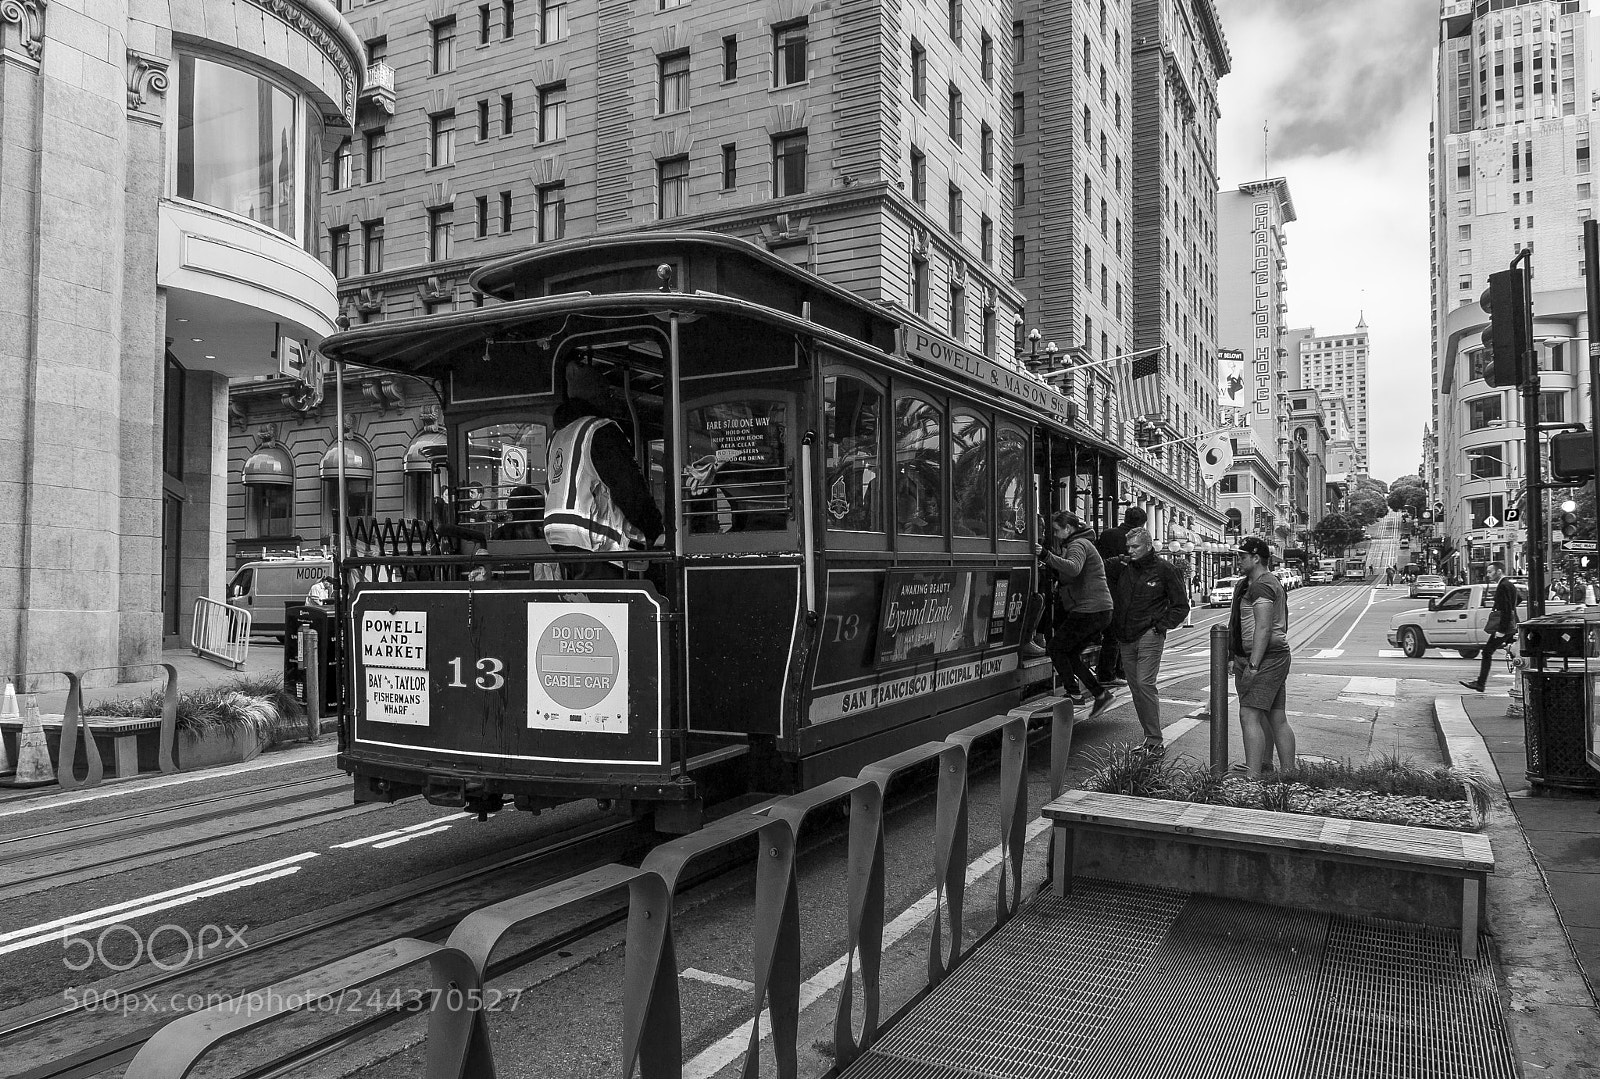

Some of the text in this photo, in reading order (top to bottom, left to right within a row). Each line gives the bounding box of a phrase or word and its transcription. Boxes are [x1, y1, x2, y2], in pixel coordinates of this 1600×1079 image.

[1254, 203, 1270, 415] CHANCELLOR HOTEL
[916, 334, 985, 379] POWELL
[990, 369, 999, 386] &
[1004, 374, 1047, 406] MASON
[706, 421, 722, 430] FARE
[740, 418, 754, 428] ONE
[755, 417, 770, 426] WAY
[929, 583, 951, 594] BEAUTY
[365, 620, 423, 634] POWELL
[551, 626, 602, 641] DO NOT
[832, 614, 860, 643] 13
[380, 634, 408, 645] AND
[559, 640, 594, 654] PASS
[364, 644, 423, 659] MARKET
[448, 656, 505, 690] 13
[368, 673, 382, 689] BAY
[394, 675, 426, 692] TAYLOR
[544, 674, 611, 689] CABLE CAR
[842, 691, 867, 713] SAN
[871, 678, 927, 705] FRANCISCO
[929, 666, 972, 691] MUNICIPAL
[373, 691, 421, 705] FISHERMANS
[384, 704, 408, 716] WHARF
